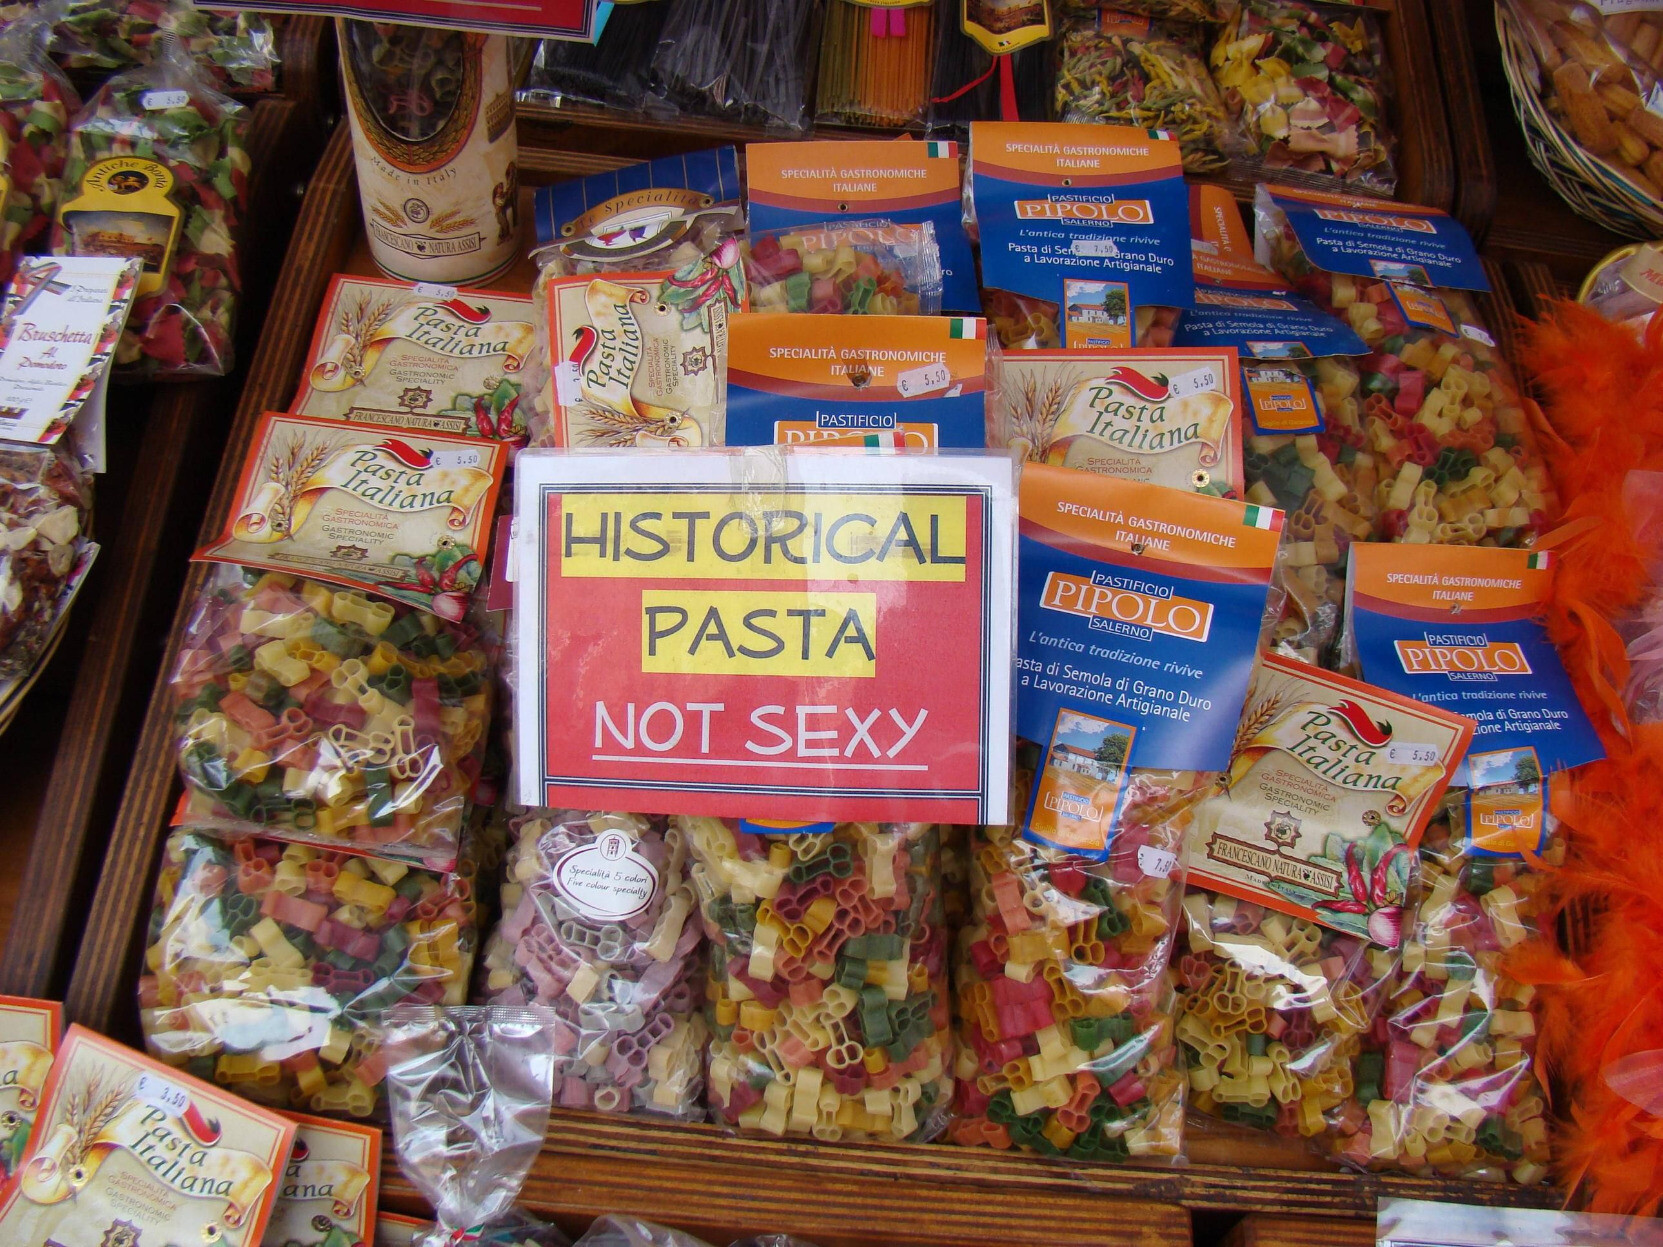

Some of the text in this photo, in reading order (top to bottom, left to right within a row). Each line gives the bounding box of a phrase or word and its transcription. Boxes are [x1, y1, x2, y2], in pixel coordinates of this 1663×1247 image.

[1006, 143, 1150, 156] SPECIALITÀ GASTRONOMICHE
[370, 156, 458, 186] Made in Italy
[781, 167, 928, 179] SPECIALITÀ GASTRONOMICHE
[1056, 159, 1100, 168] ITALIANE
[86, 160, 139, 192] Antiche
[833, 183, 878, 192] ITALIANE
[1052, 195, 1111, 204] PASTIFICIO
[1025, 204, 1144, 222] PIPOLO
[1064, 218, 1110, 227] SALERNO
[1325, 210, 1427, 230] PIPOLO
[373, 224, 477, 254] FRANCESCANO NATURA ASSISI
[1020, 229, 1161, 246] L'antica tradizione rivive
[1324, 227, 1446, 250] L'antica tradizione rivive
[1008, 242, 1174, 266] Pasta di Duro
[1316, 238, 1462, 264] Pasta di Semola di Grano Duro
[1340, 246, 1399, 259] Lavorazione
[1401, 252, 1453, 268] Artigianale
[1034, 254, 1100, 268] Lavorazione
[1103, 256, 1162, 274] Artigianale
[18, 322, 94, 344] Bruschetta
[414, 307, 482, 338] Pasta
[1184, 322, 1212, 332] Pasta
[1226, 320, 1264, 329] Semola
[1212, 328, 1272, 336] Lavorazione
[1274, 329, 1328, 338] Artigianale
[404, 322, 509, 356] Italiana
[608, 303, 640, 390] Italiana
[17, 356, 68, 370] Pomodoro
[586, 328, 617, 389] Pasta
[770, 346, 946, 363] SPECIALITÀ GASTRONOMICHE
[389, 360, 459, 372] GASTRONOMICA
[389, 369, 456, 380] GASTRONOMIC
[831, 365, 884, 378] ITALIANE
[396, 377, 446, 386] SPECIALITY
[902, 380, 908, 392] €
[1172, 383, 1180, 396] €
[1088, 386, 1166, 424] Pasta
[352, 412, 462, 431] FRANCESCANO NATURA ASSISI
[821, 414, 893, 428] PASTIFICIO
[1086, 410, 1200, 450] Italiana
[350, 450, 426, 486] Pasta
[434, 456, 441, 465] €
[340, 470, 454, 508] Italiana
[321, 525, 394, 540] GASTRONOMIC
[322, 515, 399, 530] GASTRONOMICA
[1056, 501, 1236, 548] SPECIALITÀ GASTRONOMICHE
[328, 534, 384, 544] SPECIALITY
[564, 511, 967, 565] HISTORICAL
[1116, 530, 1170, 552] ITALIANE
[1096, 574, 1170, 598] PASTIFICIO
[1386, 573, 1522, 590] SPECIALITÀ GASTRONOMICHE
[1051, 580, 1202, 633] PIPOLO
[1432, 590, 1474, 602] ITALIANE
[644, 606, 876, 661] PASTA
[1092, 618, 1150, 639] SALERNO
[1428, 634, 1485, 646] PASTIFICIO
[1029, 630, 1204, 680] L'antica tradizione rivive
[1404, 648, 1520, 671] PIPOLO
[1016, 656, 1212, 711] asta di Semola di Grano Duro
[1451, 672, 1494, 680] SALERNO
[1021, 672, 1190, 722] a Lavorazione Artigianale
[1462, 690, 1516, 700] tradizione
[1518, 690, 1548, 700] rivive
[1496, 708, 1568, 720] di Grano Duro
[594, 701, 928, 760] NOT SEXY
[1504, 721, 1562, 733] Artigianale
[1300, 711, 1376, 766] Pasta
[1286, 734, 1402, 790] Italiana
[1389, 750, 1396, 760] €
[1259, 782, 1330, 812] GASTRONOMIC
[1261, 772, 1336, 803] GASTRONOMICA
[1050, 797, 1098, 818] PIPOLO
[1264, 792, 1320, 816] SPECIALITY
[569, 864, 648, 884] Specialità 5 colori
[1216, 841, 1333, 890] FRANCESCANO NATURA ASSISI
[566, 878, 648, 900] Five colour specialty
[140, 1104, 208, 1167] Pasta
[130, 1131, 234, 1196] Italiana
[108, 1174, 177, 1210] GASTRONOMICA
[105, 1186, 170, 1222] GASTRONOMIC
[110, 1199, 162, 1226] SPECIALITY
